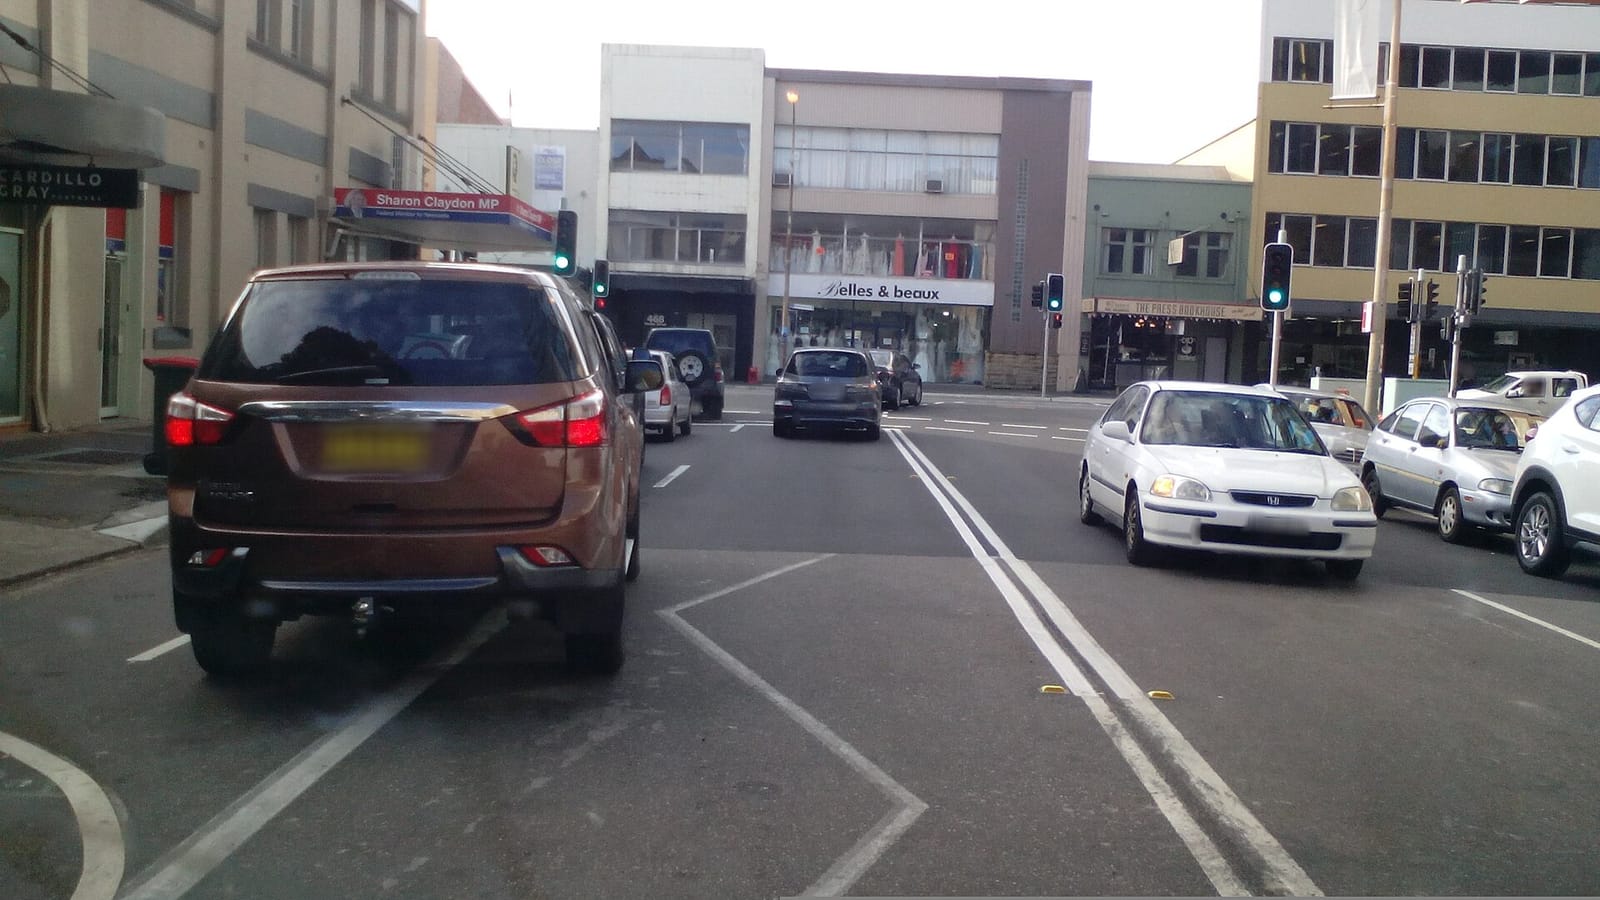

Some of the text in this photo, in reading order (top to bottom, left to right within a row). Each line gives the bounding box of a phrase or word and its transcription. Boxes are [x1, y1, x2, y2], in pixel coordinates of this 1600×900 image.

[0, 184, 49, 199] GRAY
[376, 193, 500, 210] Sharon Claydon MP
[817, 281, 940, 300] Belles & beaux
[1136, 302, 1150, 314] THE
[1151, 303, 1177, 315] PRESS
